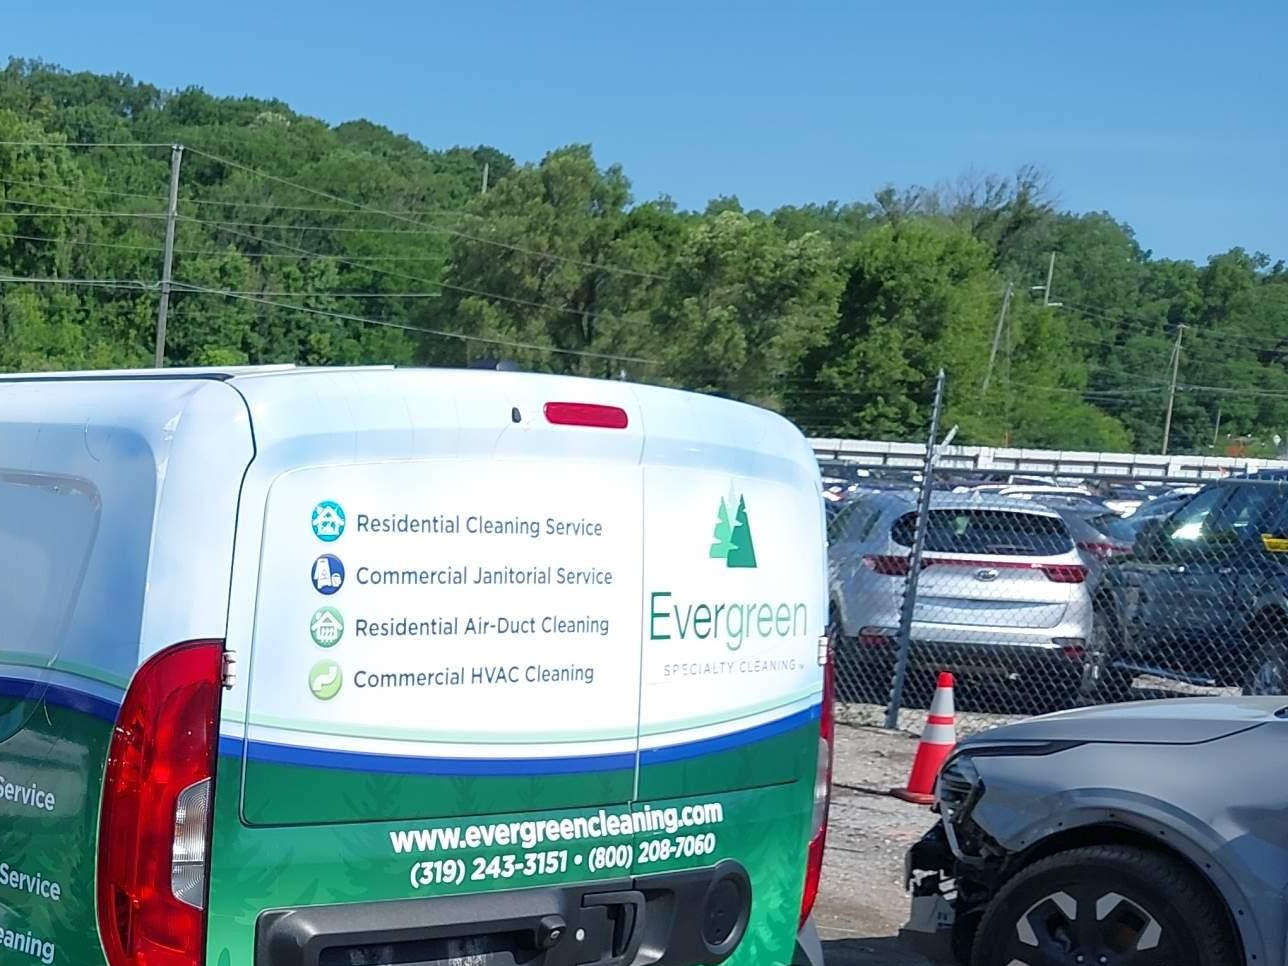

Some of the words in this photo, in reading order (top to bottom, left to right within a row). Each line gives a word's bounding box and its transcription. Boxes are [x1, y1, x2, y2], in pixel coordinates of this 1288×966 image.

[357, 514, 460, 533] Residential
[466, 516, 540, 538] Cleaning
[546, 518, 603, 537] Service
[356, 566, 467, 585] Commercial
[473, 566, 551, 585] Janitorial
[556, 567, 613, 585] Service
[355, 617, 458, 638] Residential
[464, 617, 536, 635] Air-Duct
[541, 615, 610, 636] Cleaning
[650, 591, 808, 651] Evergreen
[353, 667, 465, 688] Commercial
[471, 666, 520, 684] HVAC
[525, 664, 595, 684] Cleaning
[663, 661, 735, 677] SPECIALTY
[738, 658, 797, 673] CLEANING
[389, 801, 724, 853] www.evergreencleaning.com
[410, 861, 466, 888] (319)
[470, 849, 569, 881] 243-3151
[588, 844, 634, 872] (800)
[637, 832, 717, 863] 208-7060
